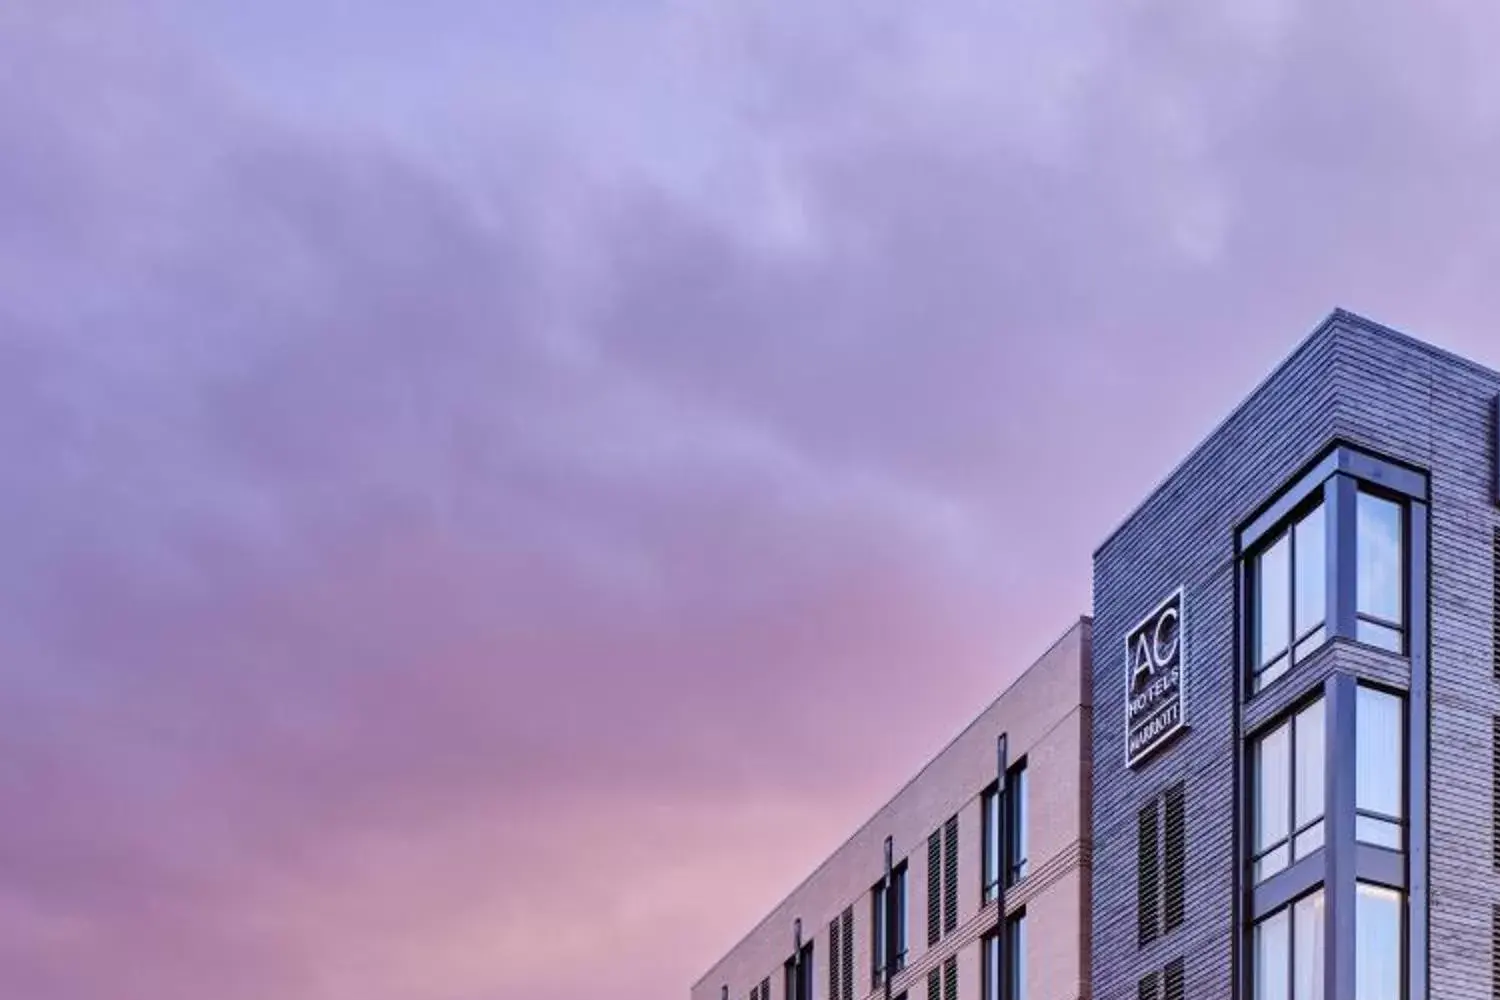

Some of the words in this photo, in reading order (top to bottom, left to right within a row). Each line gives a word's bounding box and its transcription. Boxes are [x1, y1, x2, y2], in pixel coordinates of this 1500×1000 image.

[1131, 607, 1178, 692] AC
[1129, 665, 1179, 719] HOTELS
[1129, 703, 1179, 754] MARRIOTT
